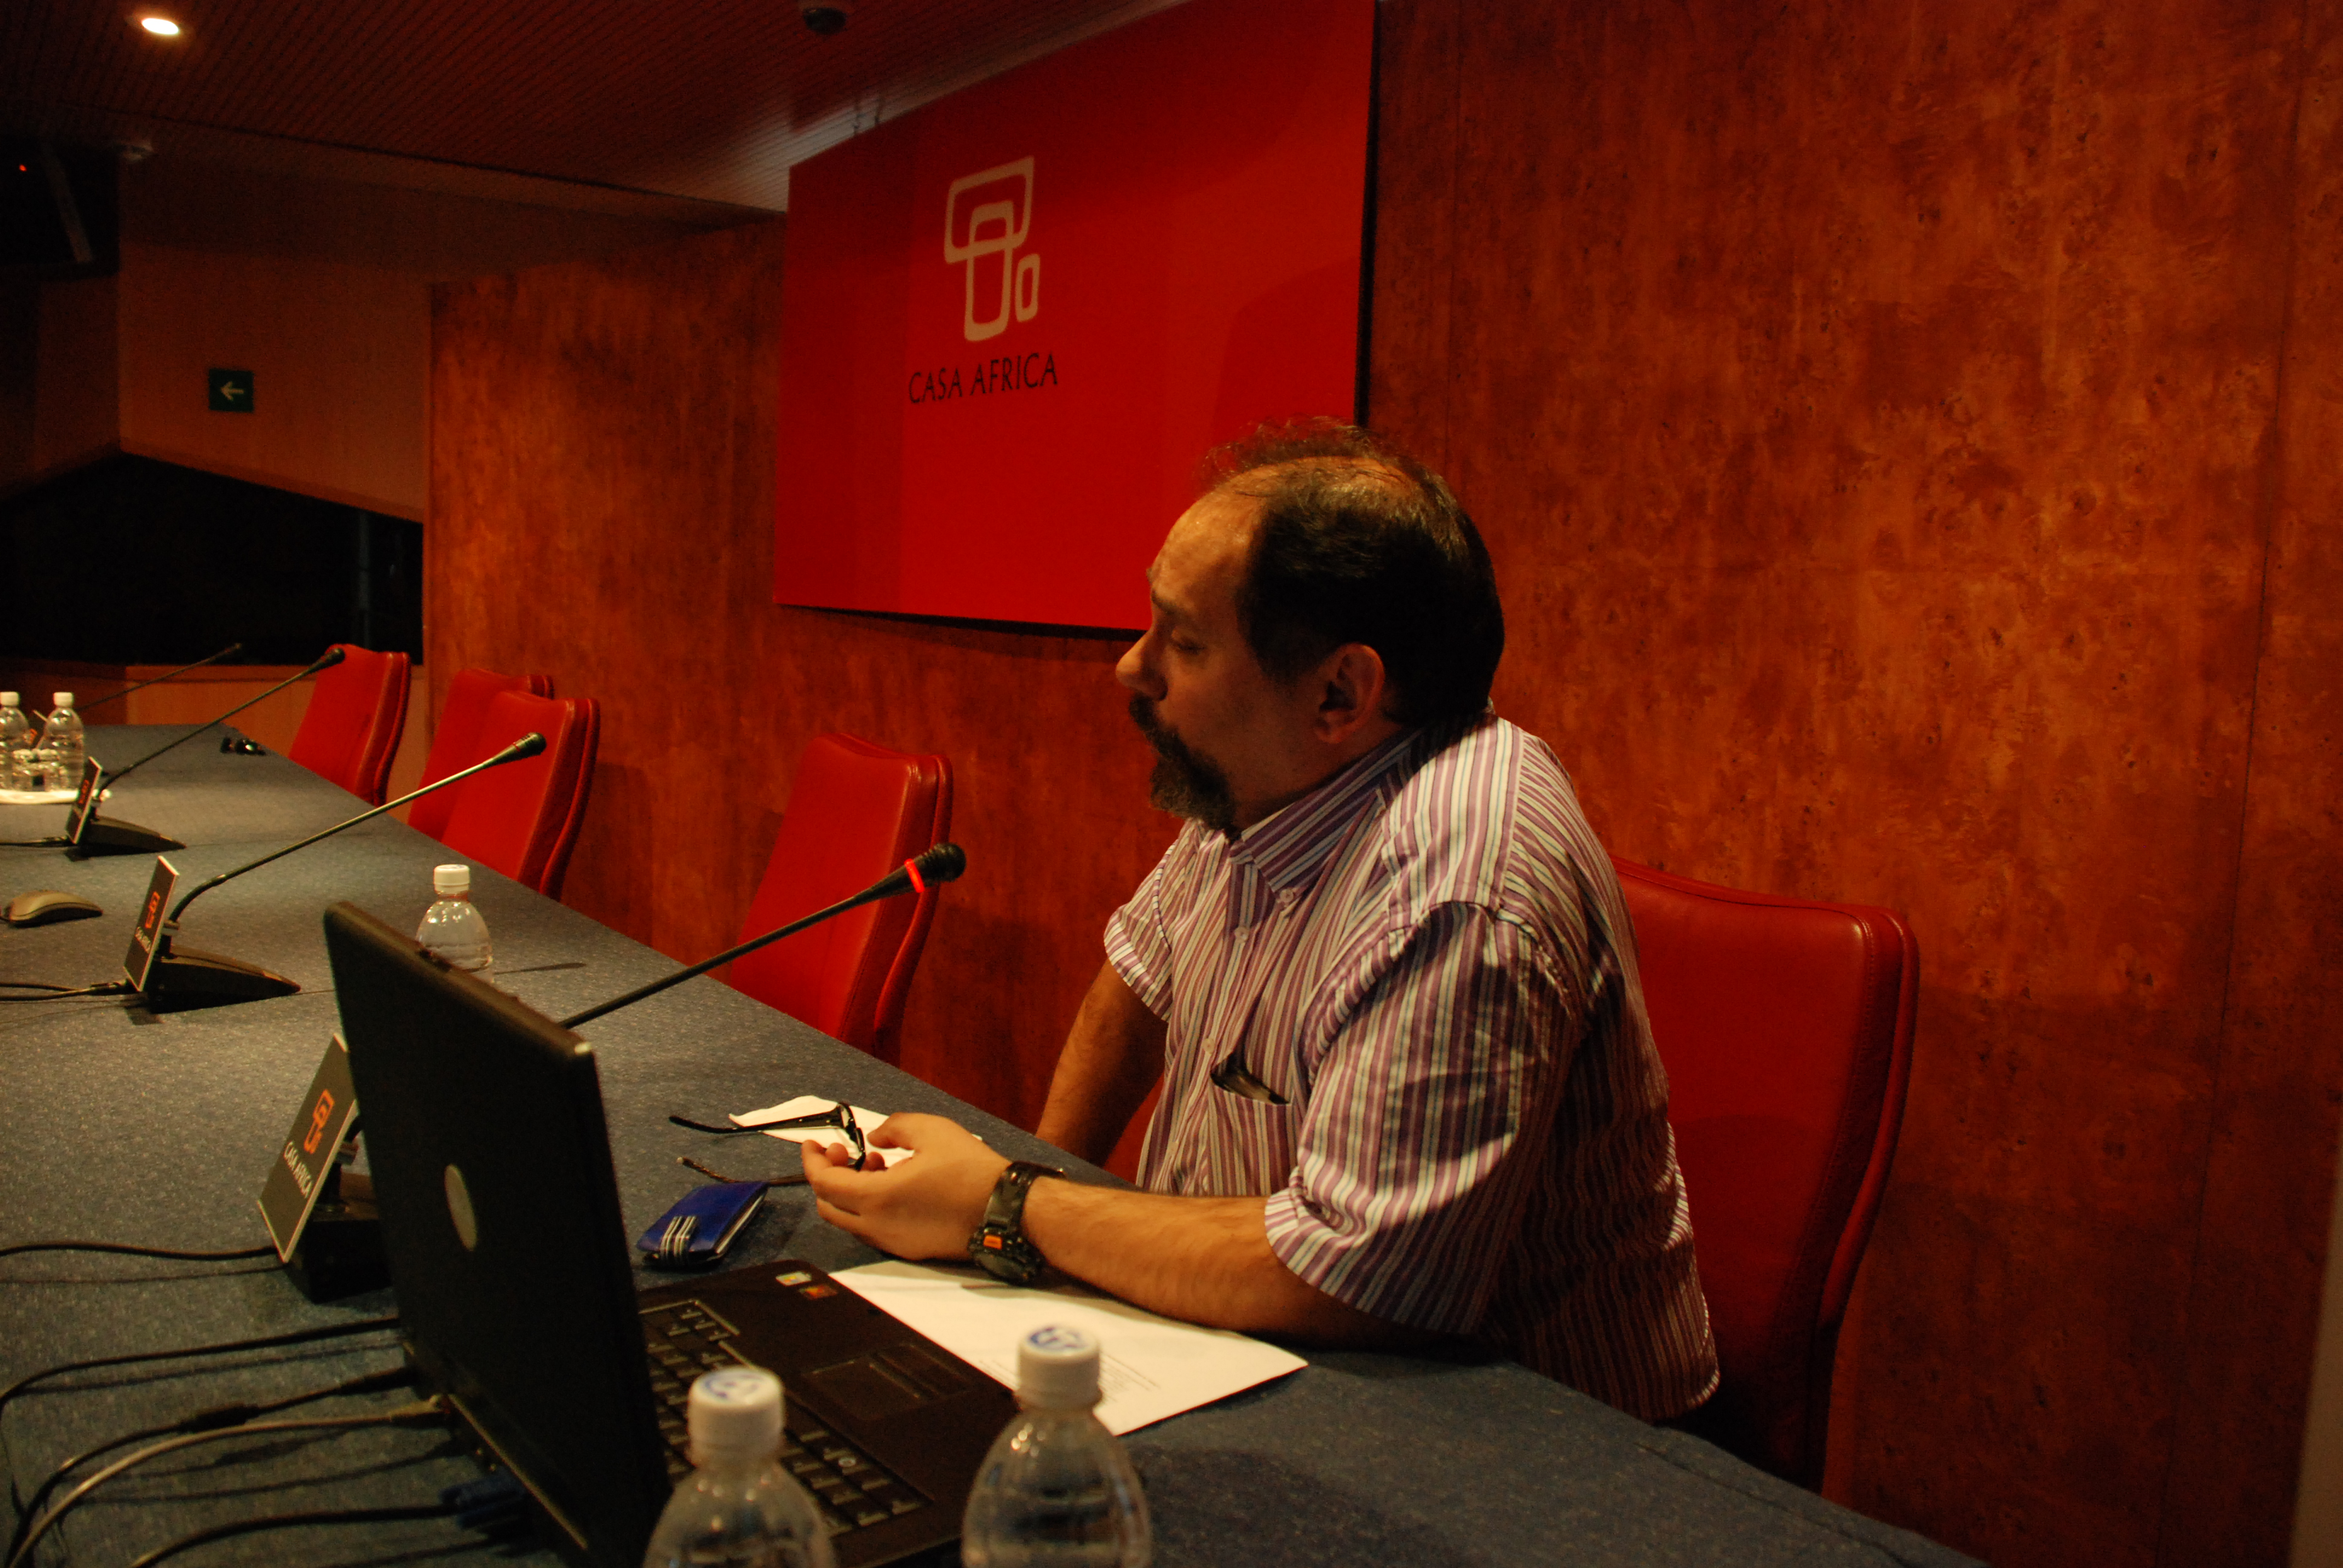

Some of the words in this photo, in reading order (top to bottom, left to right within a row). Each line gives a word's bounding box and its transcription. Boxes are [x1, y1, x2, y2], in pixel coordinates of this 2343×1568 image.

[909, 367, 963, 403] CASA
[970, 353, 1058, 396] AFRICA
[284, 1141, 299, 1171] CASA
